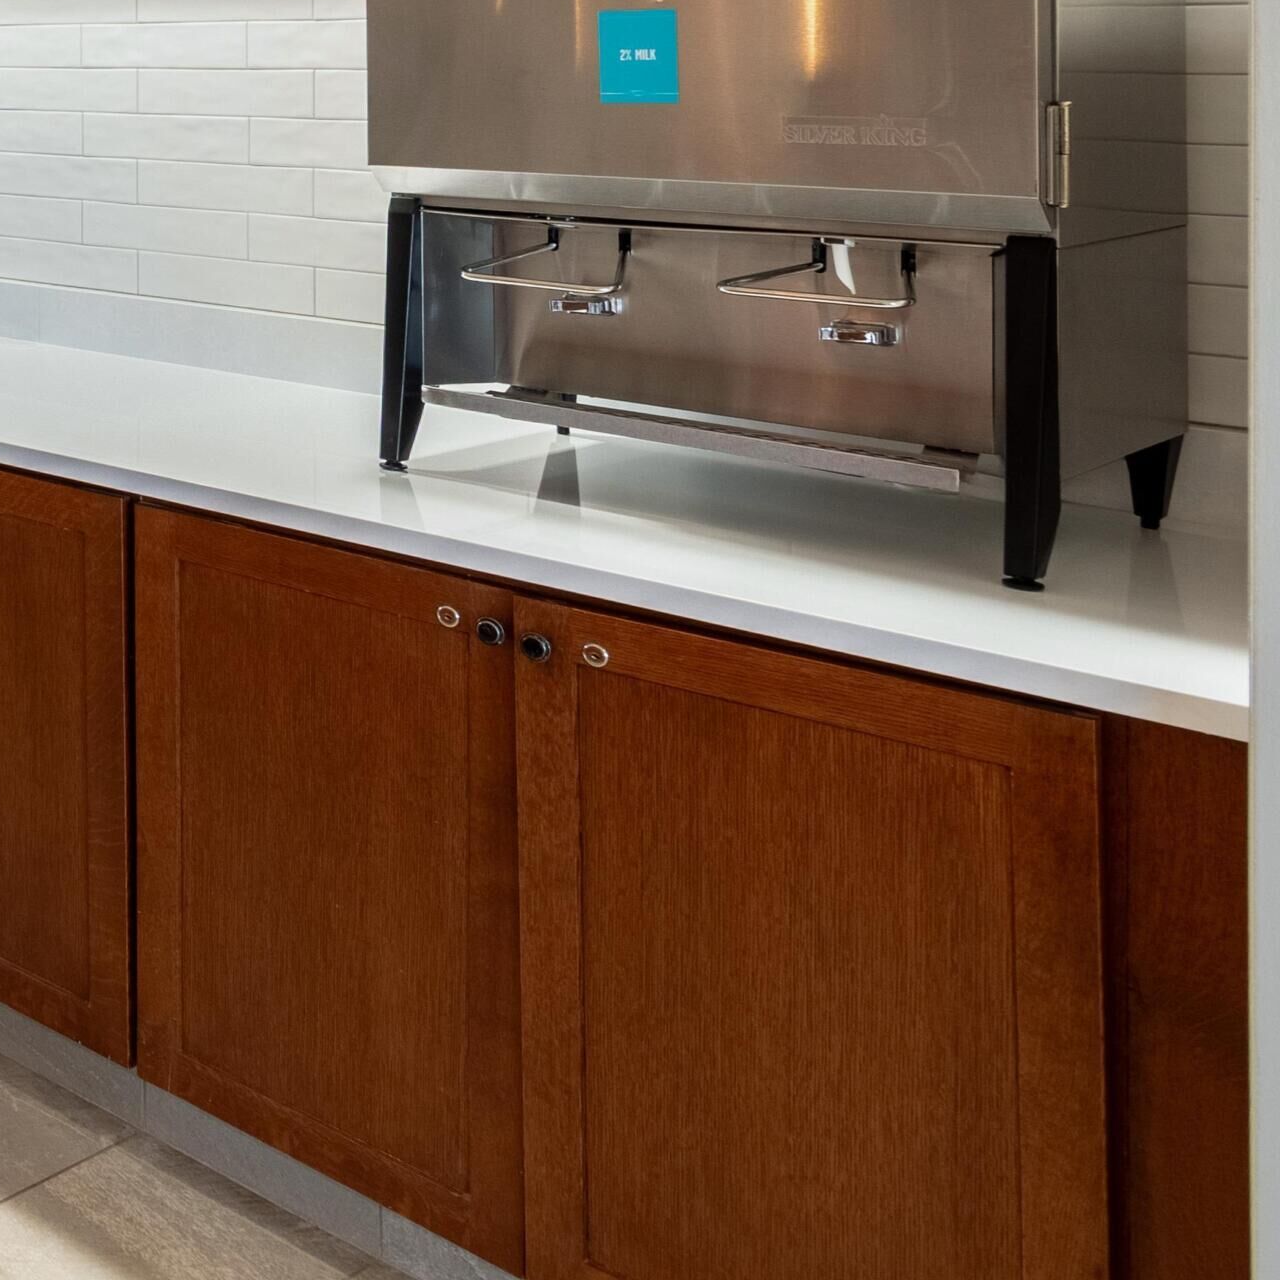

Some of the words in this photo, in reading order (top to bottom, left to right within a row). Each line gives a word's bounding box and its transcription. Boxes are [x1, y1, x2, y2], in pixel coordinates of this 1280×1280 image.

[635, 48, 657, 61] MILK
[784, 124, 858, 144] SILVER
[861, 125, 927, 146] KING
